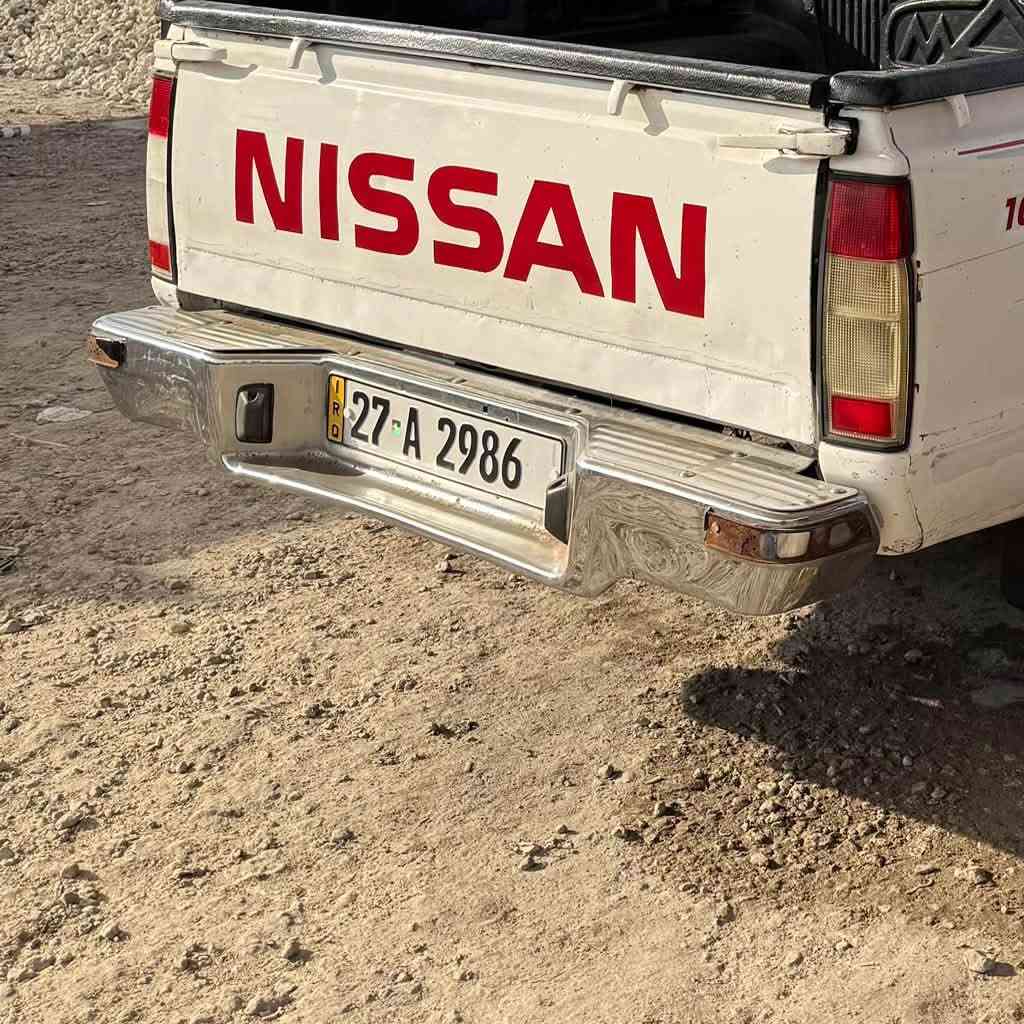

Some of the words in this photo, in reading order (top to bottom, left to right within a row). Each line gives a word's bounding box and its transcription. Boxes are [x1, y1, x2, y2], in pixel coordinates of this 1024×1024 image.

[235, 128, 707, 318] NISSAN
[350, 391, 391, 446] 27
[402, 407, 422, 461] A
[435, 417, 524, 490] 2986
